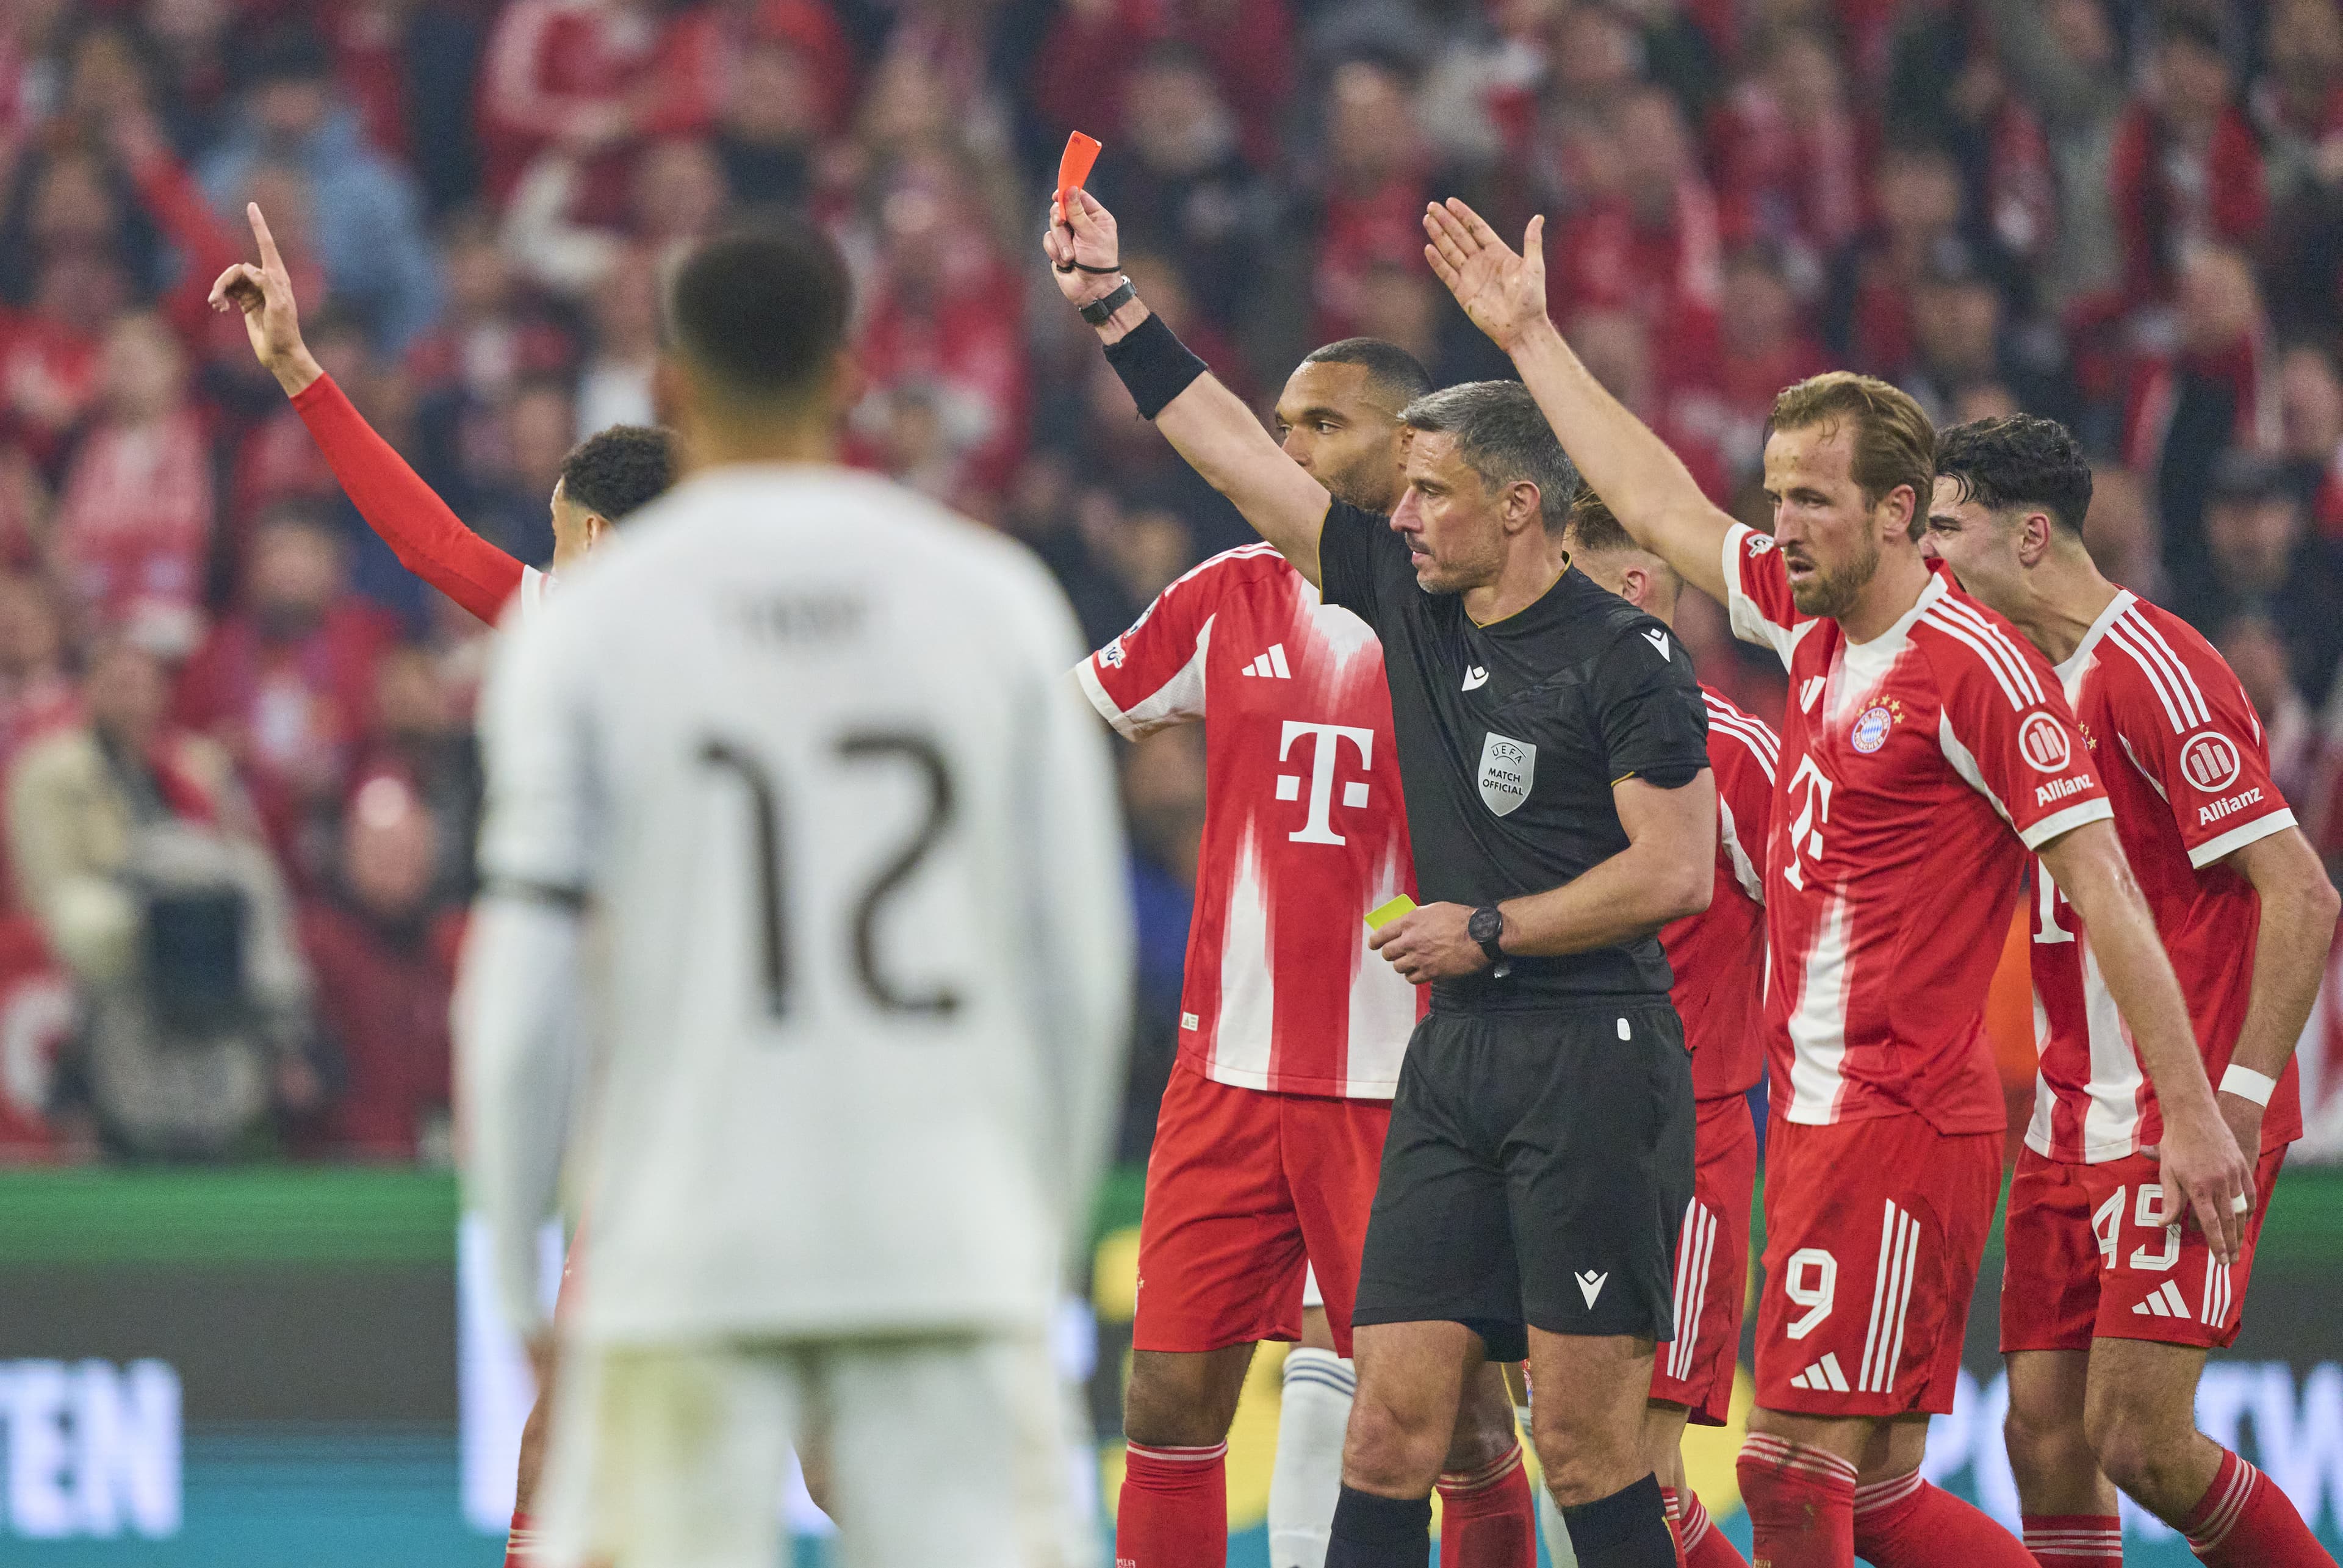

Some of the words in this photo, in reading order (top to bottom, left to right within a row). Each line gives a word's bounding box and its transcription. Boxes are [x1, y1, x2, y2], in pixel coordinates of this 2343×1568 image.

[1492, 746, 1522, 763] UEFA
[1483, 779, 1523, 795] OFFICIAL
[1488, 768, 1521, 783] MATCH
[2035, 774, 2094, 807] Allianz
[2198, 787, 2264, 825] Allianz
[689, 726, 964, 1028] 12
[2092, 1184, 2181, 1271] 45
[1785, 1248, 1838, 1340] 9
